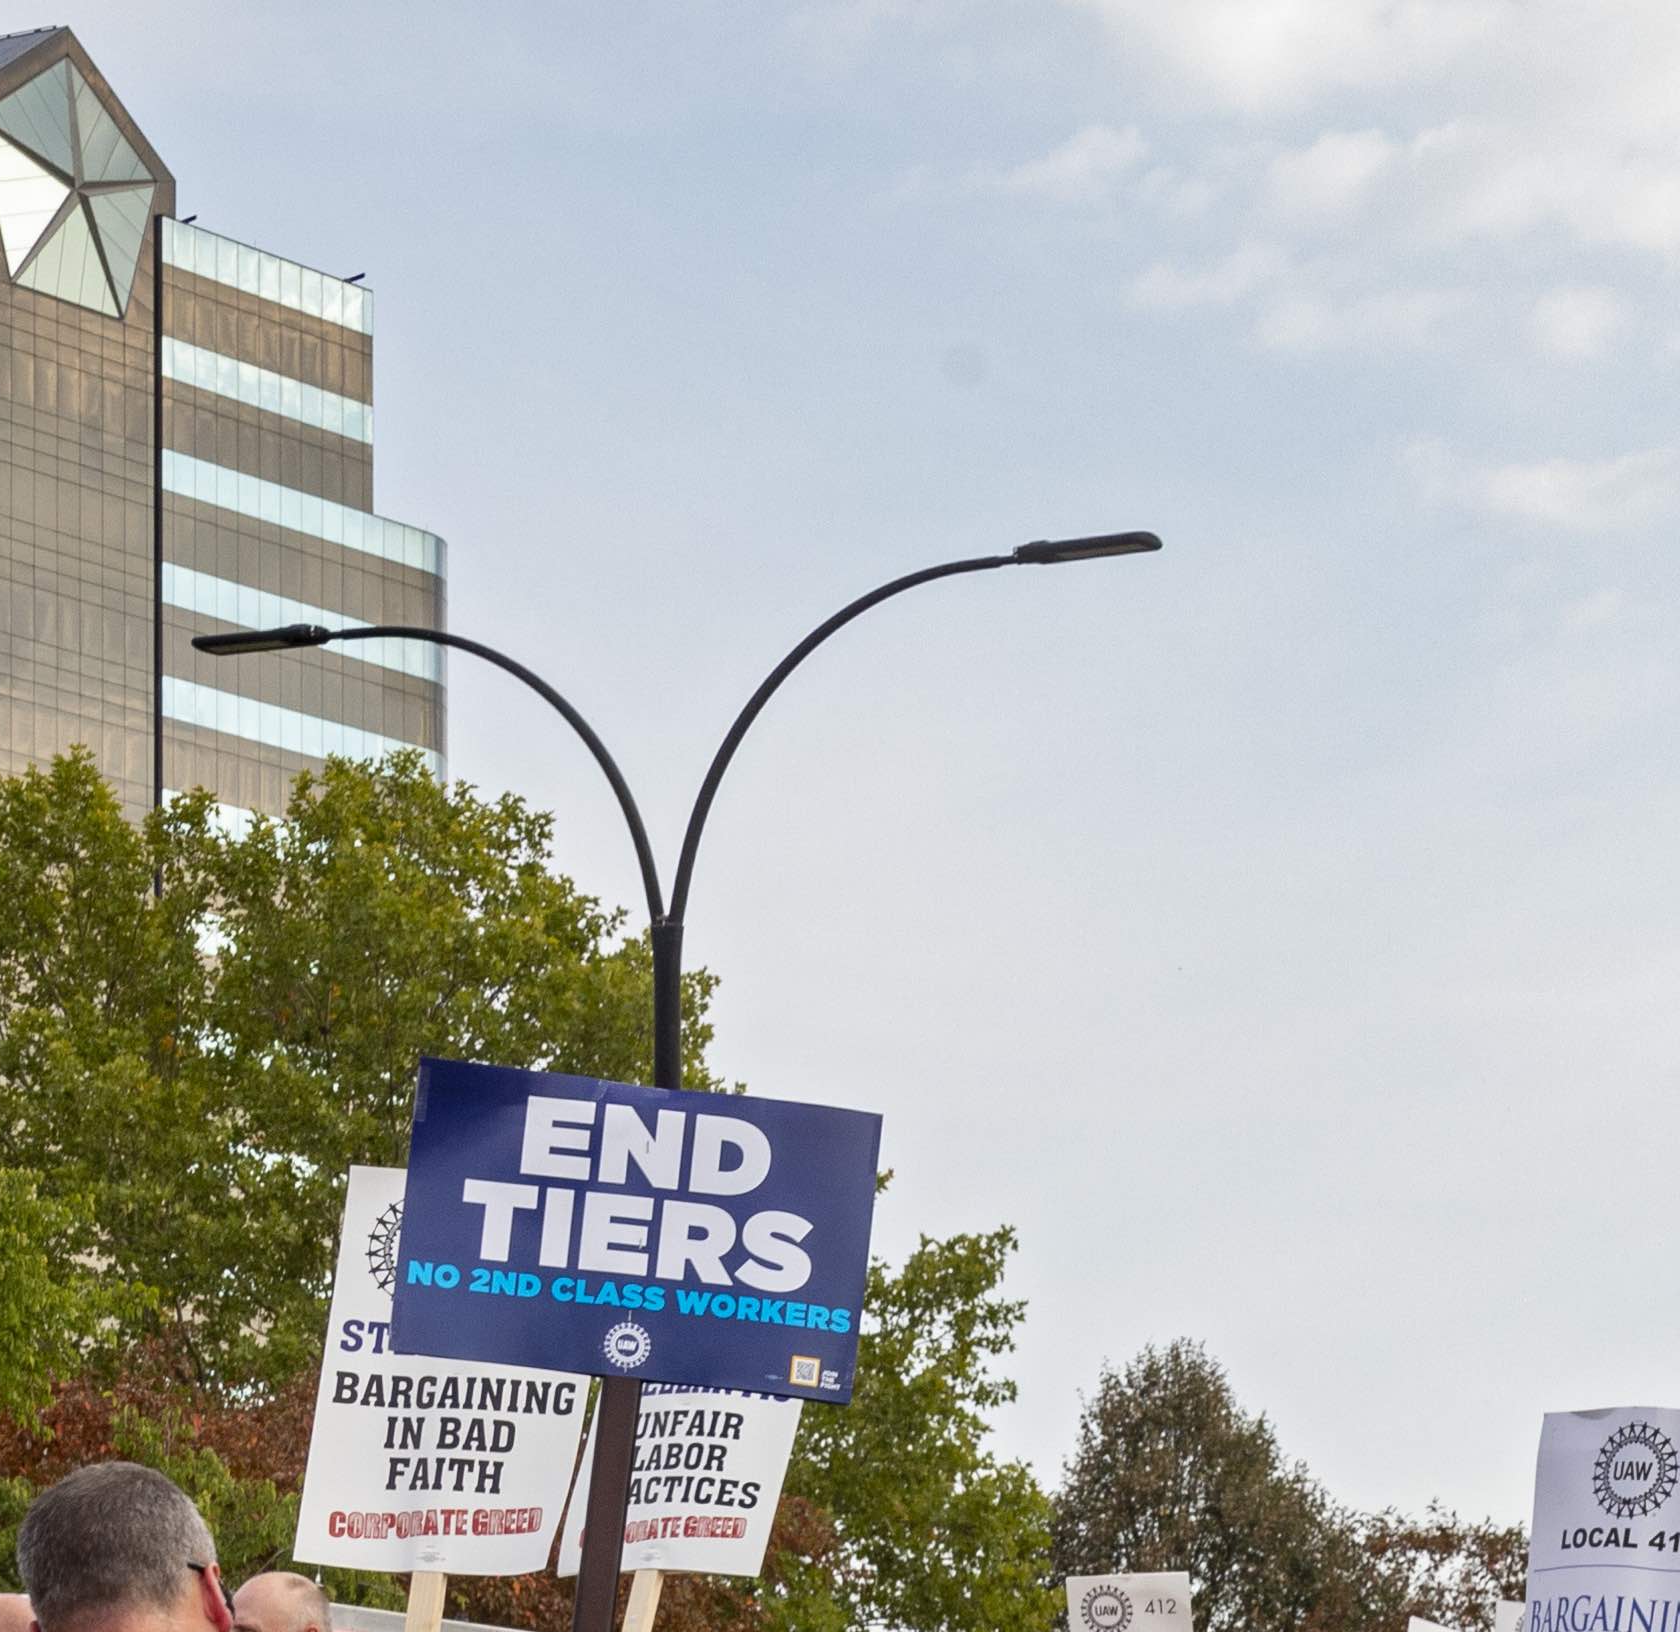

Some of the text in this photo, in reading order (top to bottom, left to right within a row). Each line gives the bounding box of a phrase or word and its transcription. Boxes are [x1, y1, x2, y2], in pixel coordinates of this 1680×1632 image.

[520, 1095, 772, 1197] END
[462, 1178, 814, 1294] TIERS
[407, 1260, 851, 1335] NO 2ND CLASS WORKERS
[332, 1370, 576, 1416] BARGAINING
[384, 1416, 516, 1453] IN BAD
[632, 1443, 728, 1472] LABOR
[1614, 1460, 1654, 1482] UAW
[385, 1457, 504, 1495] FAITH
[628, 1476, 762, 1510] ACTICES
[328, 1506, 543, 1540] CORPORATE GREED
[624, 1516, 748, 1545] ORATE GREED
[1561, 1527, 1638, 1550] LOCAL
[1095, 1599, 1178, 1617] UAW 412
